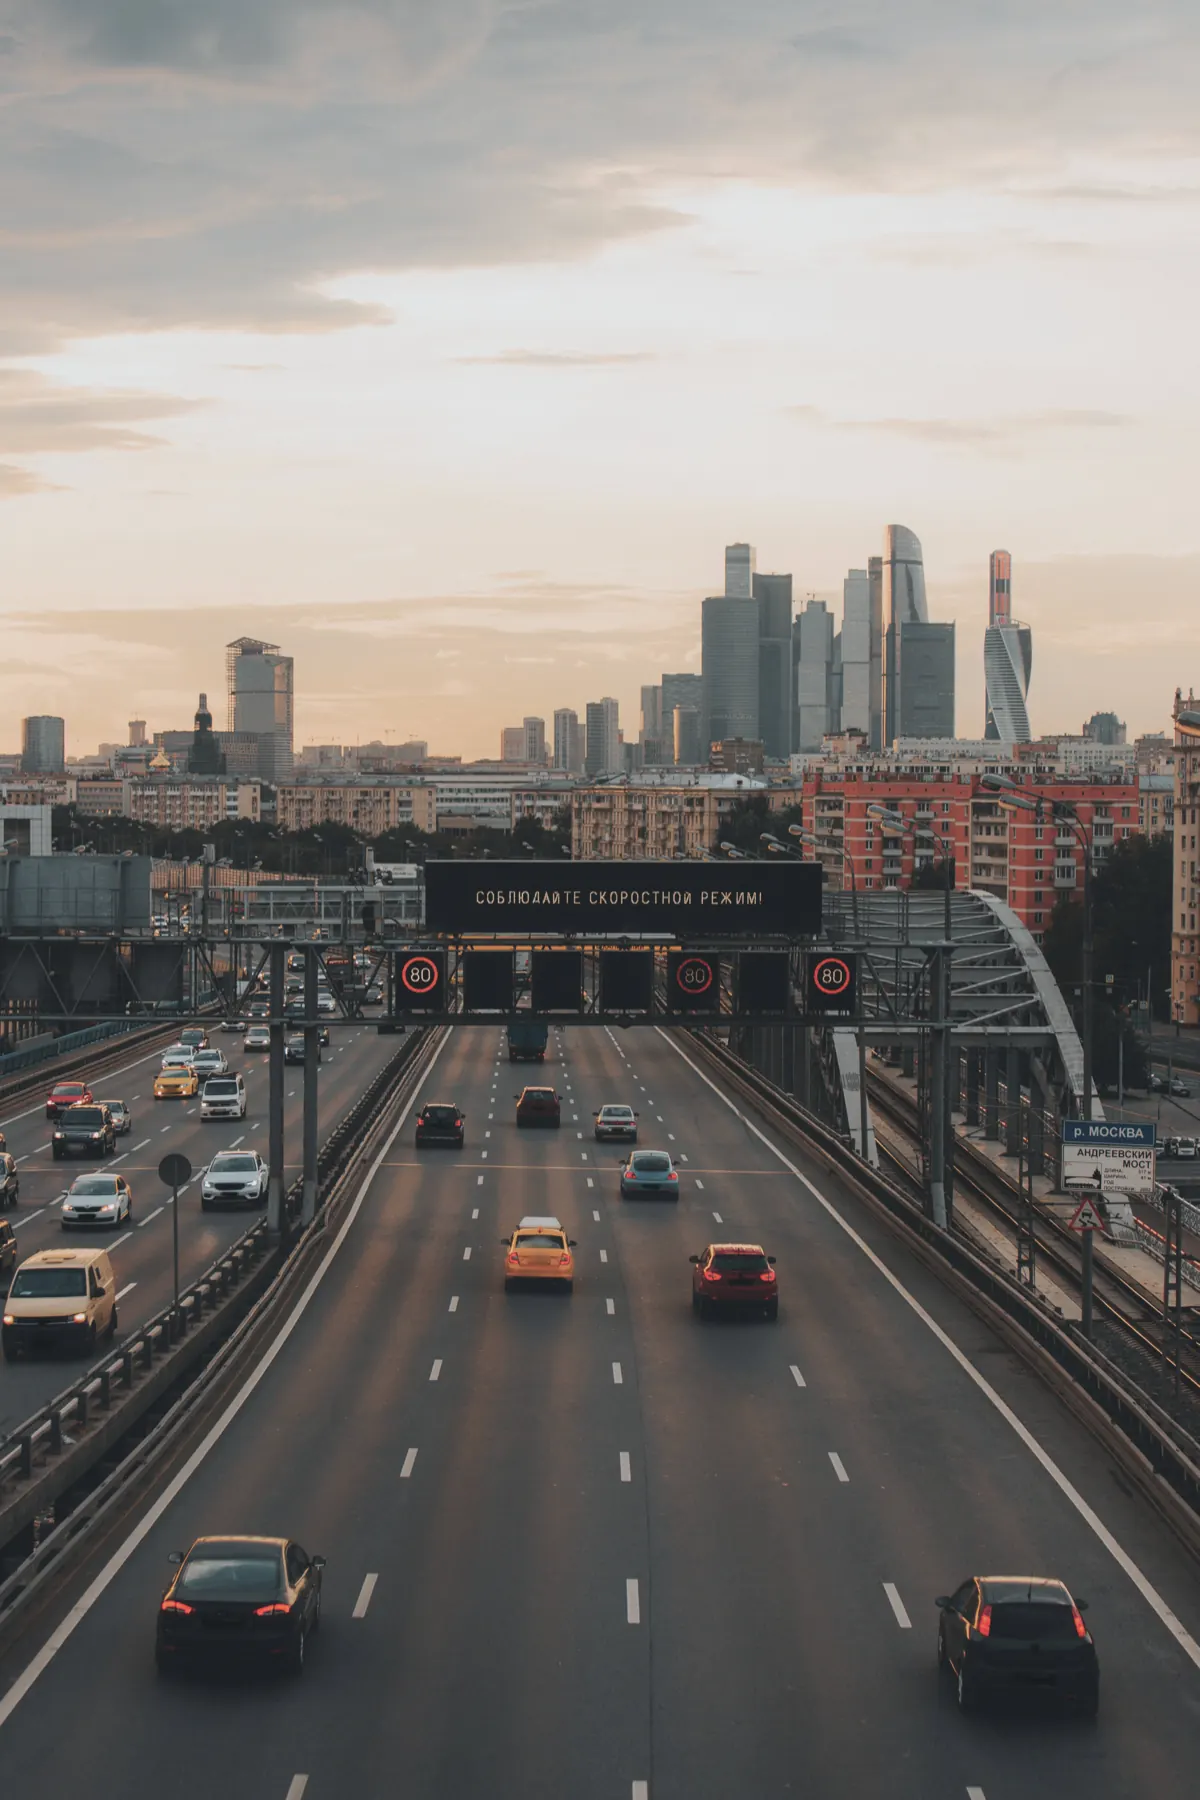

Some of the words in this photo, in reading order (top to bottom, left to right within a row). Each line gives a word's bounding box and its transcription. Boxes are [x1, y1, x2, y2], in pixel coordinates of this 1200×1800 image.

[476, 890, 581, 905] СОБЛЮДАЙТЕ
[589, 890, 692, 905] СКОРОСТНОЙ
[700, 890, 763, 905] РЕЖИМ!
[410, 967, 431, 983] 80
[685, 967, 705, 984] 80
[822, 968, 843, 984] 80
[1074, 1127, 1085, 1138] р.
[1089, 1126, 1144, 1139] МОСКВА
[1077, 1148, 1152, 1159] АНДРЕЕВСКИЙ
[1122, 1160, 1152, 1169] МОСТ
